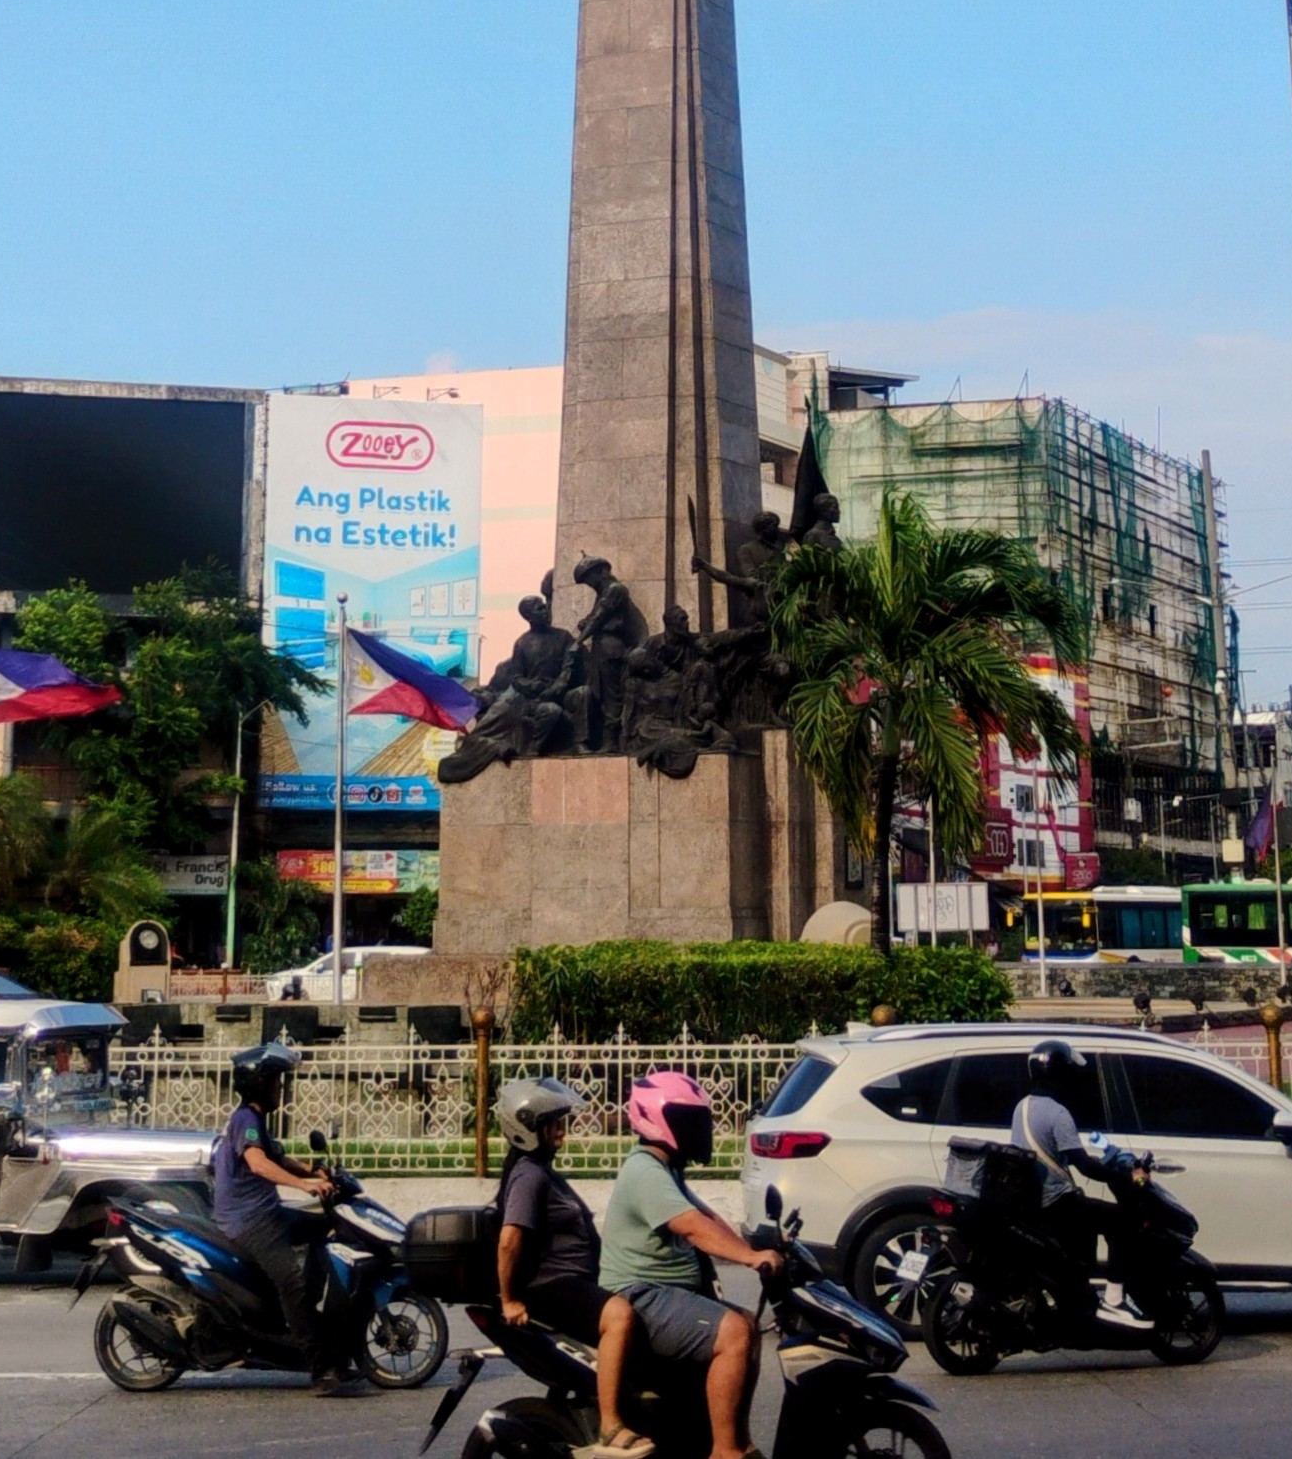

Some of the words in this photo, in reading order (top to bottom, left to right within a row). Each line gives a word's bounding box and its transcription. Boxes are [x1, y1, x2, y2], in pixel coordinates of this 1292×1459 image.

[295, 485, 350, 515] Ang
[359, 487, 451, 513] Plastik
[294, 524, 332, 544] na
[341, 521, 457, 549] Estetik!
[195, 874, 224, 887] Drug
